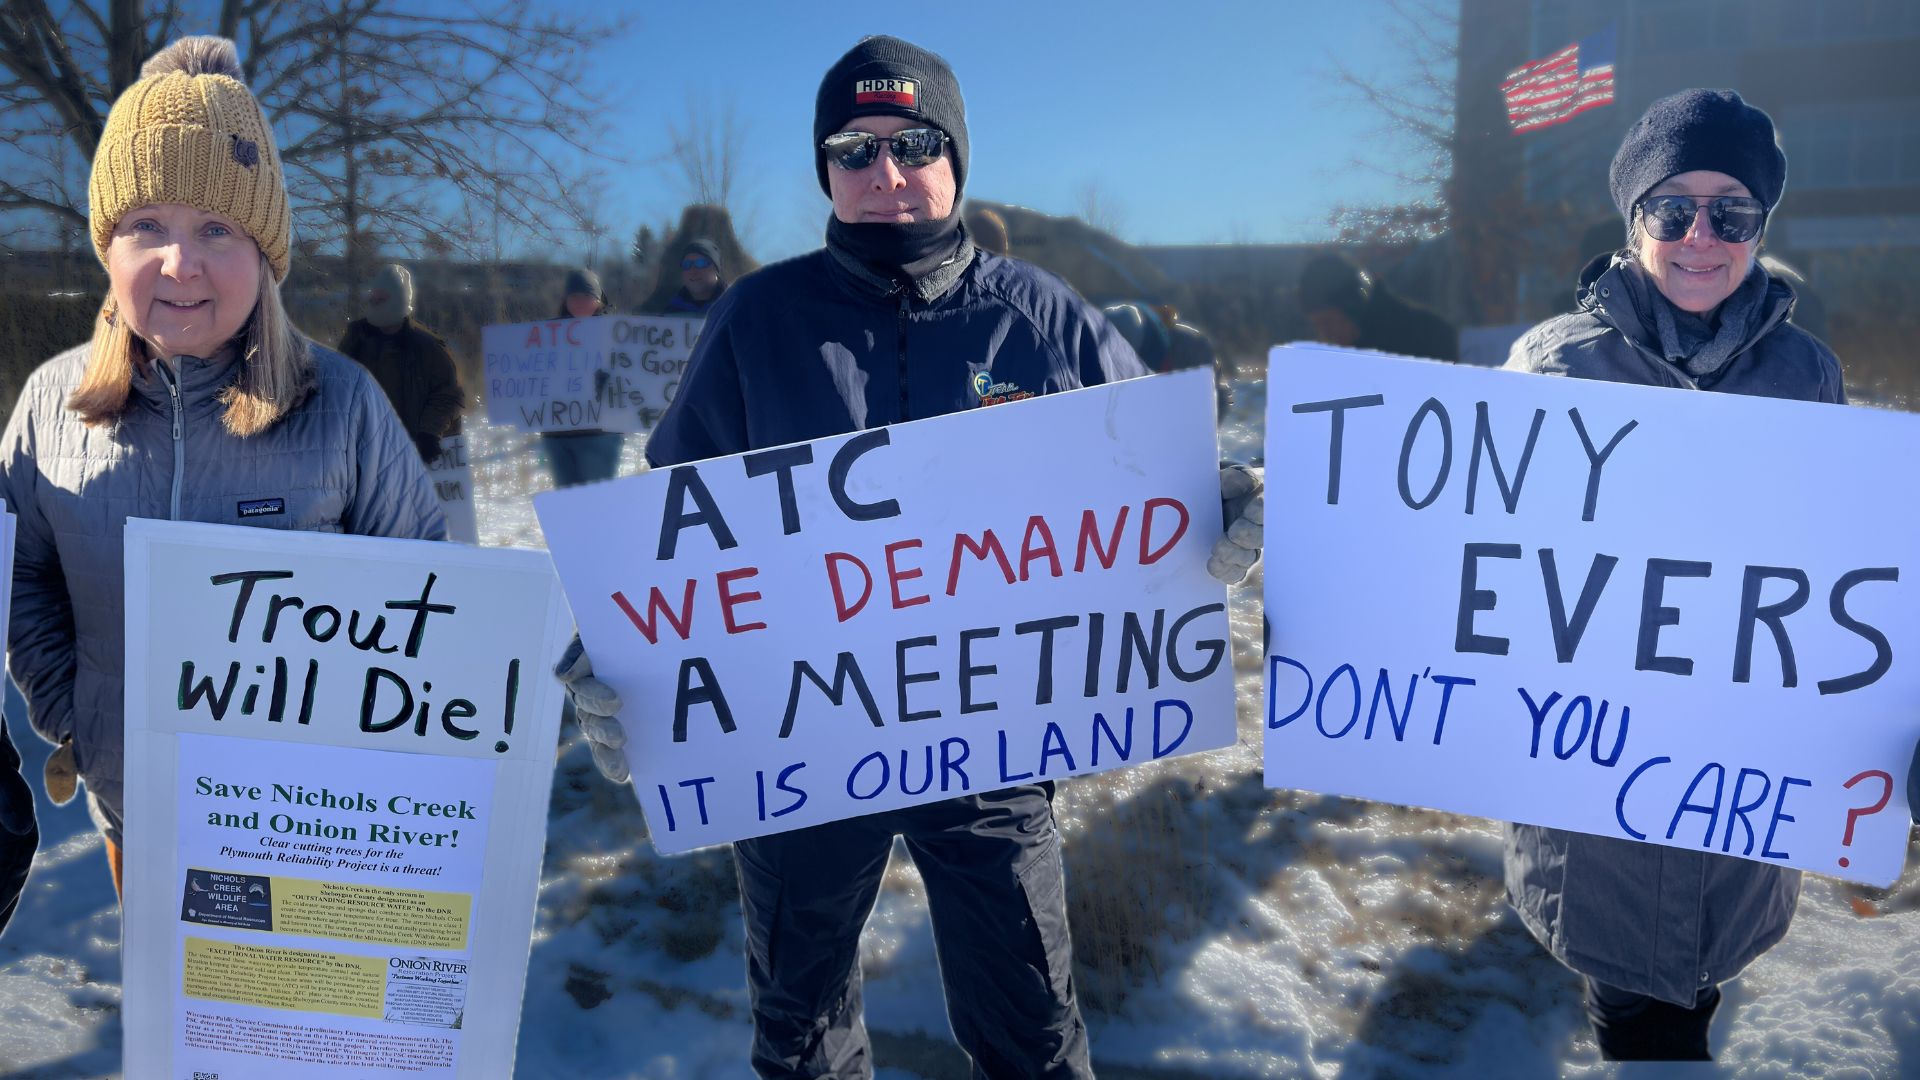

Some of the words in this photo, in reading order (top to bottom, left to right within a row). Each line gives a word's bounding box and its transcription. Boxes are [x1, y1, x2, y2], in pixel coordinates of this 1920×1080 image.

[863, 80, 906, 91] HDRT
[525, 320, 583, 348] ATC
[487, 351, 557, 374] POWER
[492, 377, 551, 398] ROUTE
[1292, 393, 1640, 522] TONY
[656, 427, 902, 561] ATC
[243, 506, 279, 515] patagonia
[610, 567, 767, 645] WE
[824, 497, 1190, 623] DEMAND
[209, 569, 457, 658] Trout
[1454, 541, 1899, 696] EVERS
[672, 656, 738, 742] A
[778, 603, 1227, 739] MEETING
[177, 656, 319, 725] Will
[358, 657, 521, 754] Die!
[1267, 655, 1476, 745] DON'T
[1517, 686, 1631, 768] YOU
[658, 776, 716, 832] IT
[755, 761, 808, 821] IS
[845, 736, 970, 800] OUR
[997, 698, 1193, 784] LAND
[195, 775, 262, 800] Save
[271, 783, 377, 812] Nichols
[388, 794, 476, 820] Creek
[207, 811, 259, 829] and
[269, 814, 357, 840] Onion
[368, 823, 460, 848] River!
[219, 846, 273, 861] Plymouth
[276, 852, 334, 869] Reliability
[336, 858, 378, 871] Project
[380, 862, 390, 872] is
[402, 864, 443, 876] threat!
[259, 836, 290, 849] Clear
[293, 842, 333, 855] cutting
[335, 845, 362, 856] trees
[363, 847, 383, 859] for
[385, 849, 404, 860] the
[210, 873, 246, 884] NICHOLS
[213, 883, 241, 893] CREEK
[323, 883, 344, 891] Nichols
[208, 892, 247, 903] WILDLIFE
[214, 903, 239, 912] AREA
[390, 956, 431, 971] ONION
[433, 960, 467, 974] RIVER
